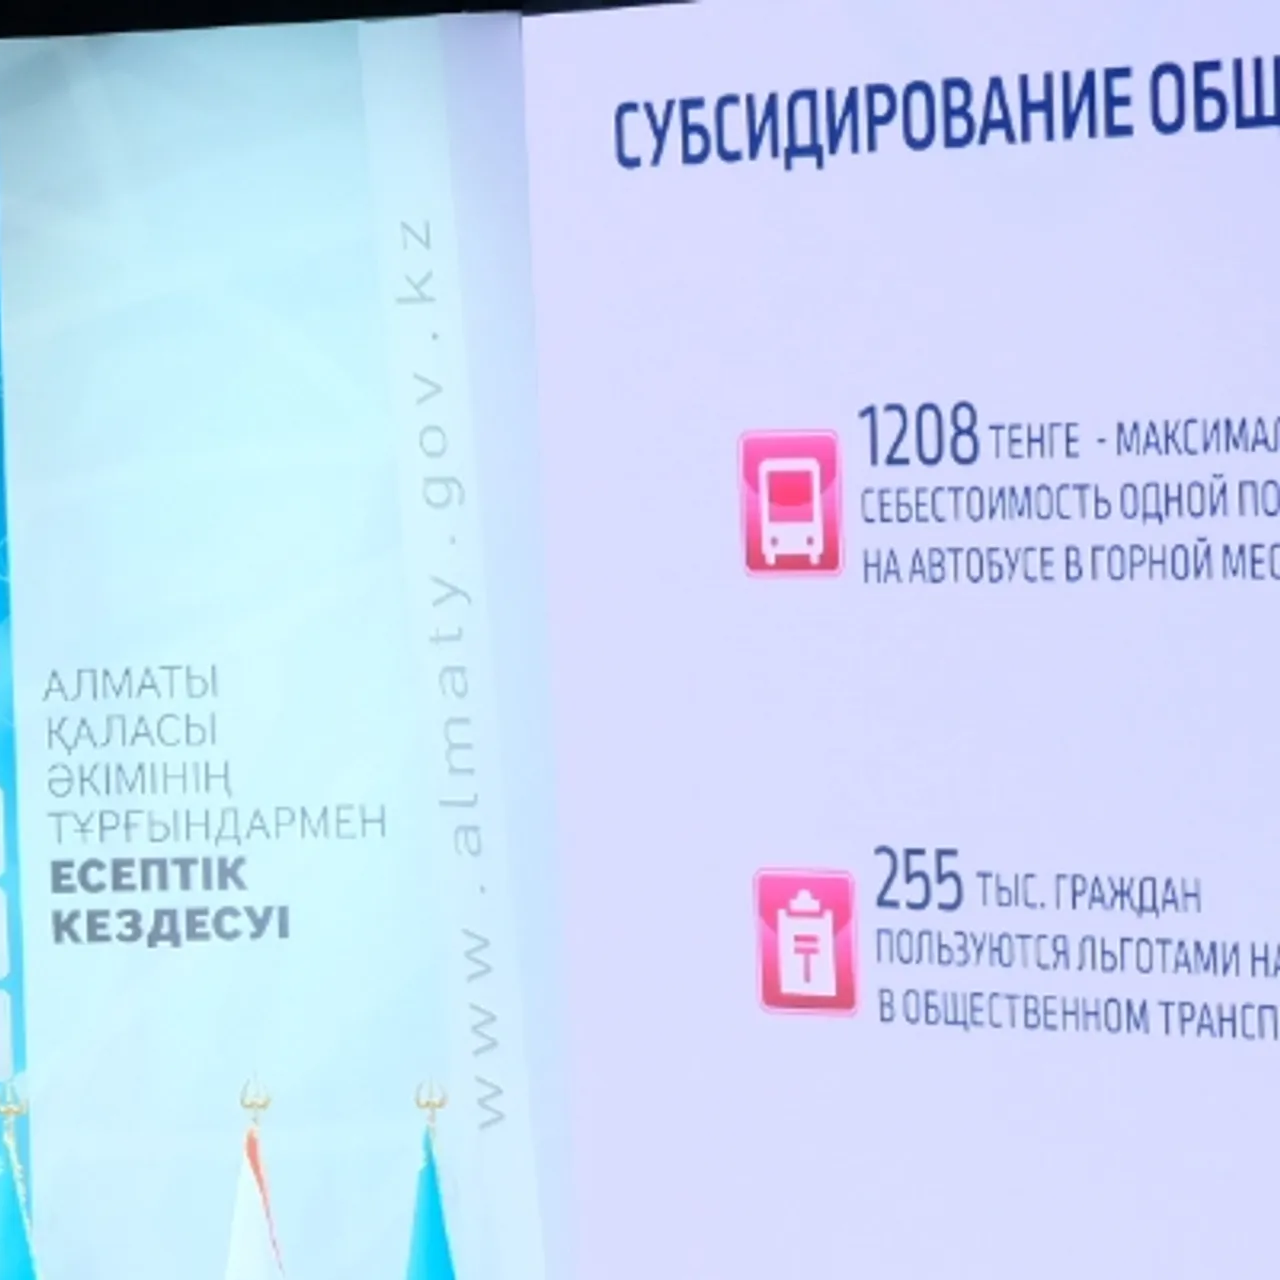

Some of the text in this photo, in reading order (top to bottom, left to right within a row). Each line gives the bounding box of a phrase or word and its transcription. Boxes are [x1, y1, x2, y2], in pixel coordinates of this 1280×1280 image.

[614, 66, 1134, 170] СУБСИДИРОВАНИЕ
[858, 401, 980, 466] 1208
[989, 422, 1080, 459] ТЕНГЕ
[861, 484, 1112, 524] СЕБЕСТОИМОСТЬ
[1120, 473, 1228, 525] ОДНОЙ
[863, 547, 902, 584] НА
[909, 546, 1055, 584] АВТОБУСЕ
[1065, 545, 1083, 582] В
[1091, 537, 1213, 582] ГОРНОЙ
[42, 664, 219, 703] АЛМАТЫ
[46, 712, 218, 755] ҚАЛАСЫ
[47, 761, 233, 798] ӘКІМІНІҢ
[47, 804, 388, 848] ТҰРҒЫНДАРМЕН
[50, 856, 249, 893] ЕСЕПТІК
[873, 845, 1203, 918] 255 ТЫС. ГРАЖДАН
[52, 906, 291, 948] КЕЗДЕСУІ
[875, 928, 1071, 970] ПОЛЬЗУЮТСЯ
[1077, 935, 1241, 977] ЛЬГОТАМИ
[878, 988, 1280, 1042] В ОБЩЕСТВЕННОМ ТРАНСП
